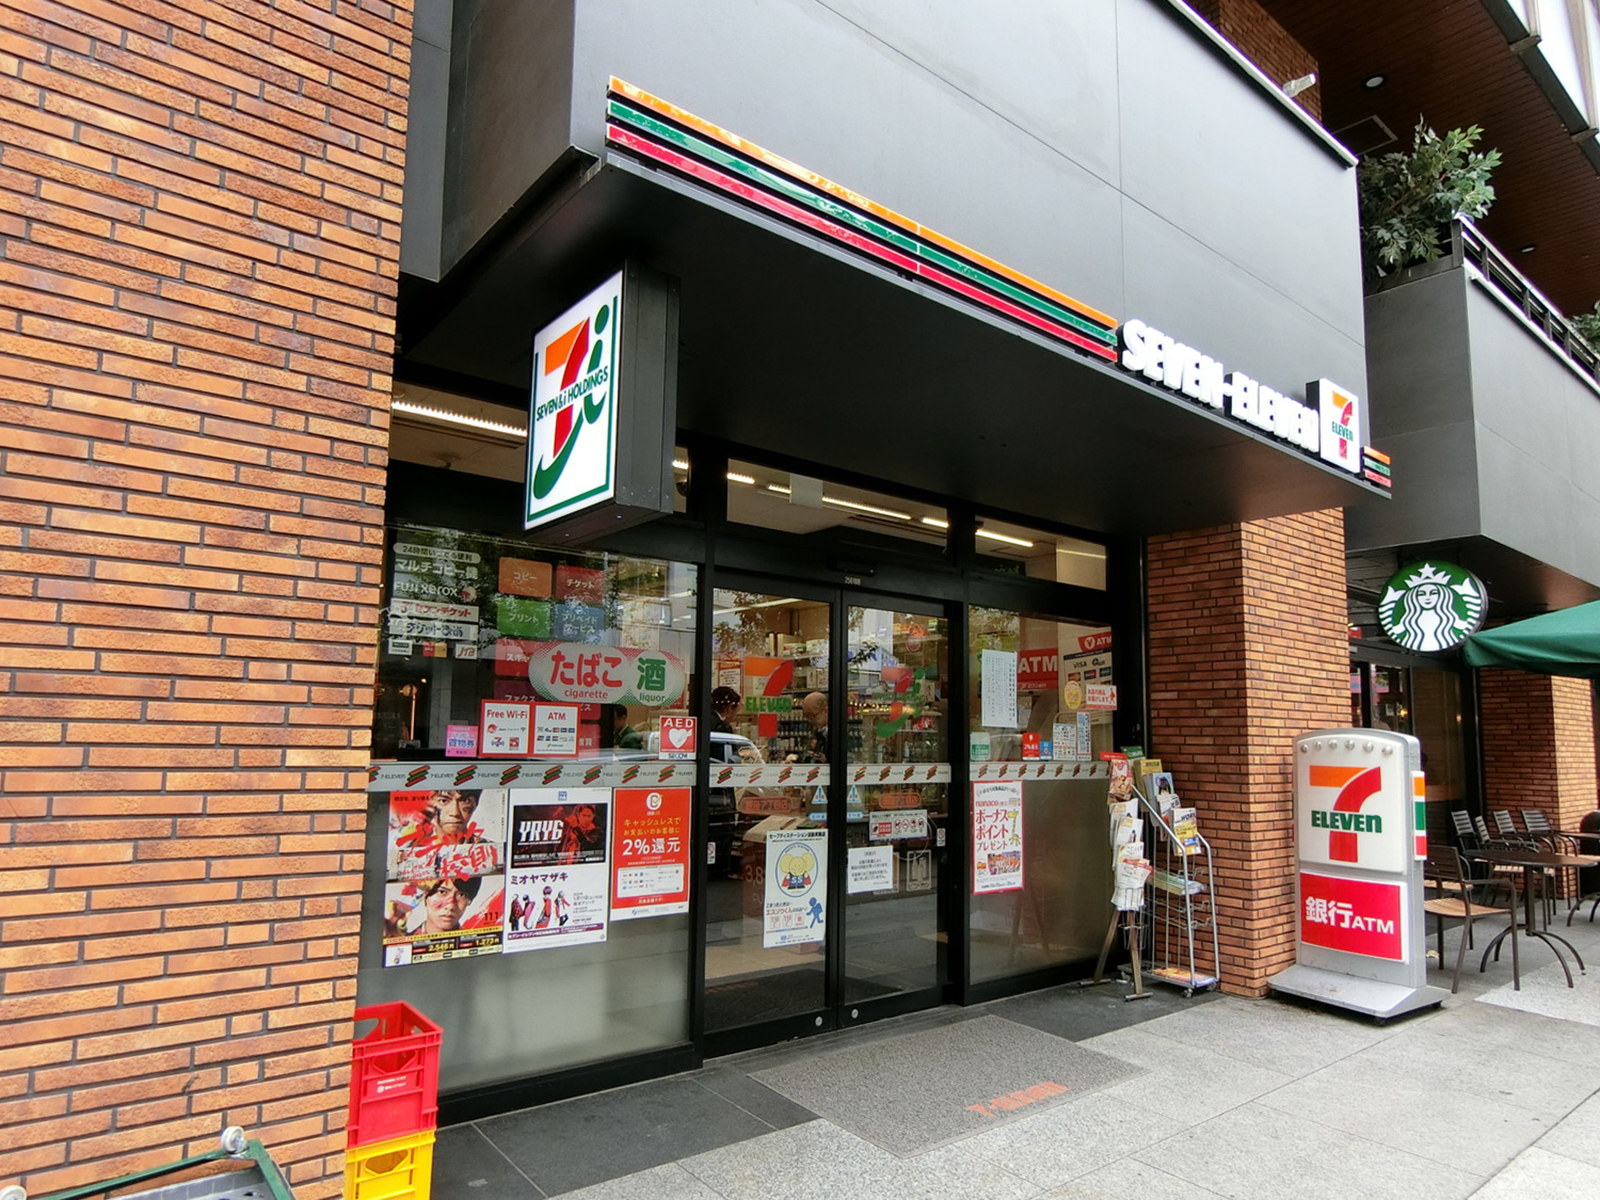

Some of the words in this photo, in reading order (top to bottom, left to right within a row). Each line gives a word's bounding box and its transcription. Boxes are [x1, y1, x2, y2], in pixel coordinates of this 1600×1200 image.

[567, 365, 609, 402] HOLDINGS
[512, 571, 538, 581] コピー
[566, 578, 595, 590] チケット
[420, 584, 458, 597] xerox
[509, 612, 539, 624] プリント
[457, 646, 476, 658] JTB
[550, 650, 623, 688] たばこ
[1018, 655, 1058, 673] ATM
[1073, 661, 1087, 669] VISA
[636, 656, 667, 692] 酒
[564, 687, 609, 700] cigarette
[639, 692, 666, 702] liquor
[486, 709, 505, 719] Free
[506, 710, 528, 720] Wi-Fi
[547, 711, 567, 721] ATM
[663, 717, 694, 729] AED
[623, 817, 681, 827] キャッシュレスで
[976, 808, 1009, 825] ボーナス
[519, 820, 564, 842] YRY6
[623, 827, 680, 836] お支払いのお客様に
[976, 823, 1009, 841] ポイント
[622, 837, 681, 856] 2%還元
[976, 840, 1008, 852] プレゼント
[510, 872, 568, 885] ミオヤマザキ
[791, 875, 803, 884] SS
[1305, 895, 1395, 935] 銀行ATM
